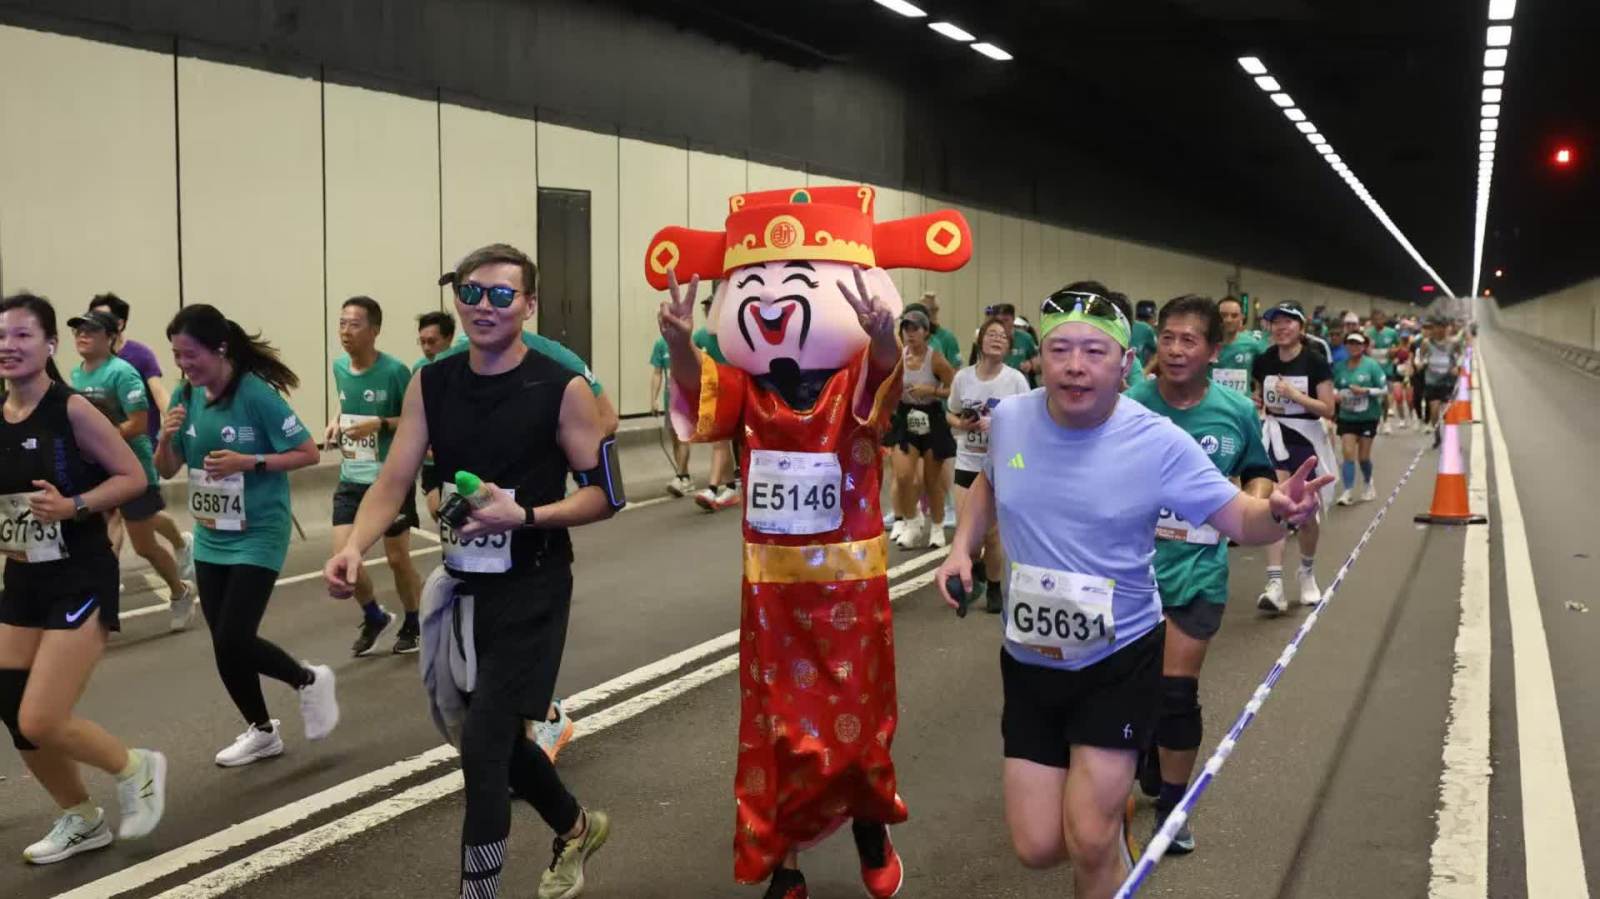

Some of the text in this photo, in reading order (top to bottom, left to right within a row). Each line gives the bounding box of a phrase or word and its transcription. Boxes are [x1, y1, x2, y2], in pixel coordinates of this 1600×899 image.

[192, 492, 241, 514] G5874
[752, 482, 836, 511] E5146
[1014, 602, 1106, 641] G5631
